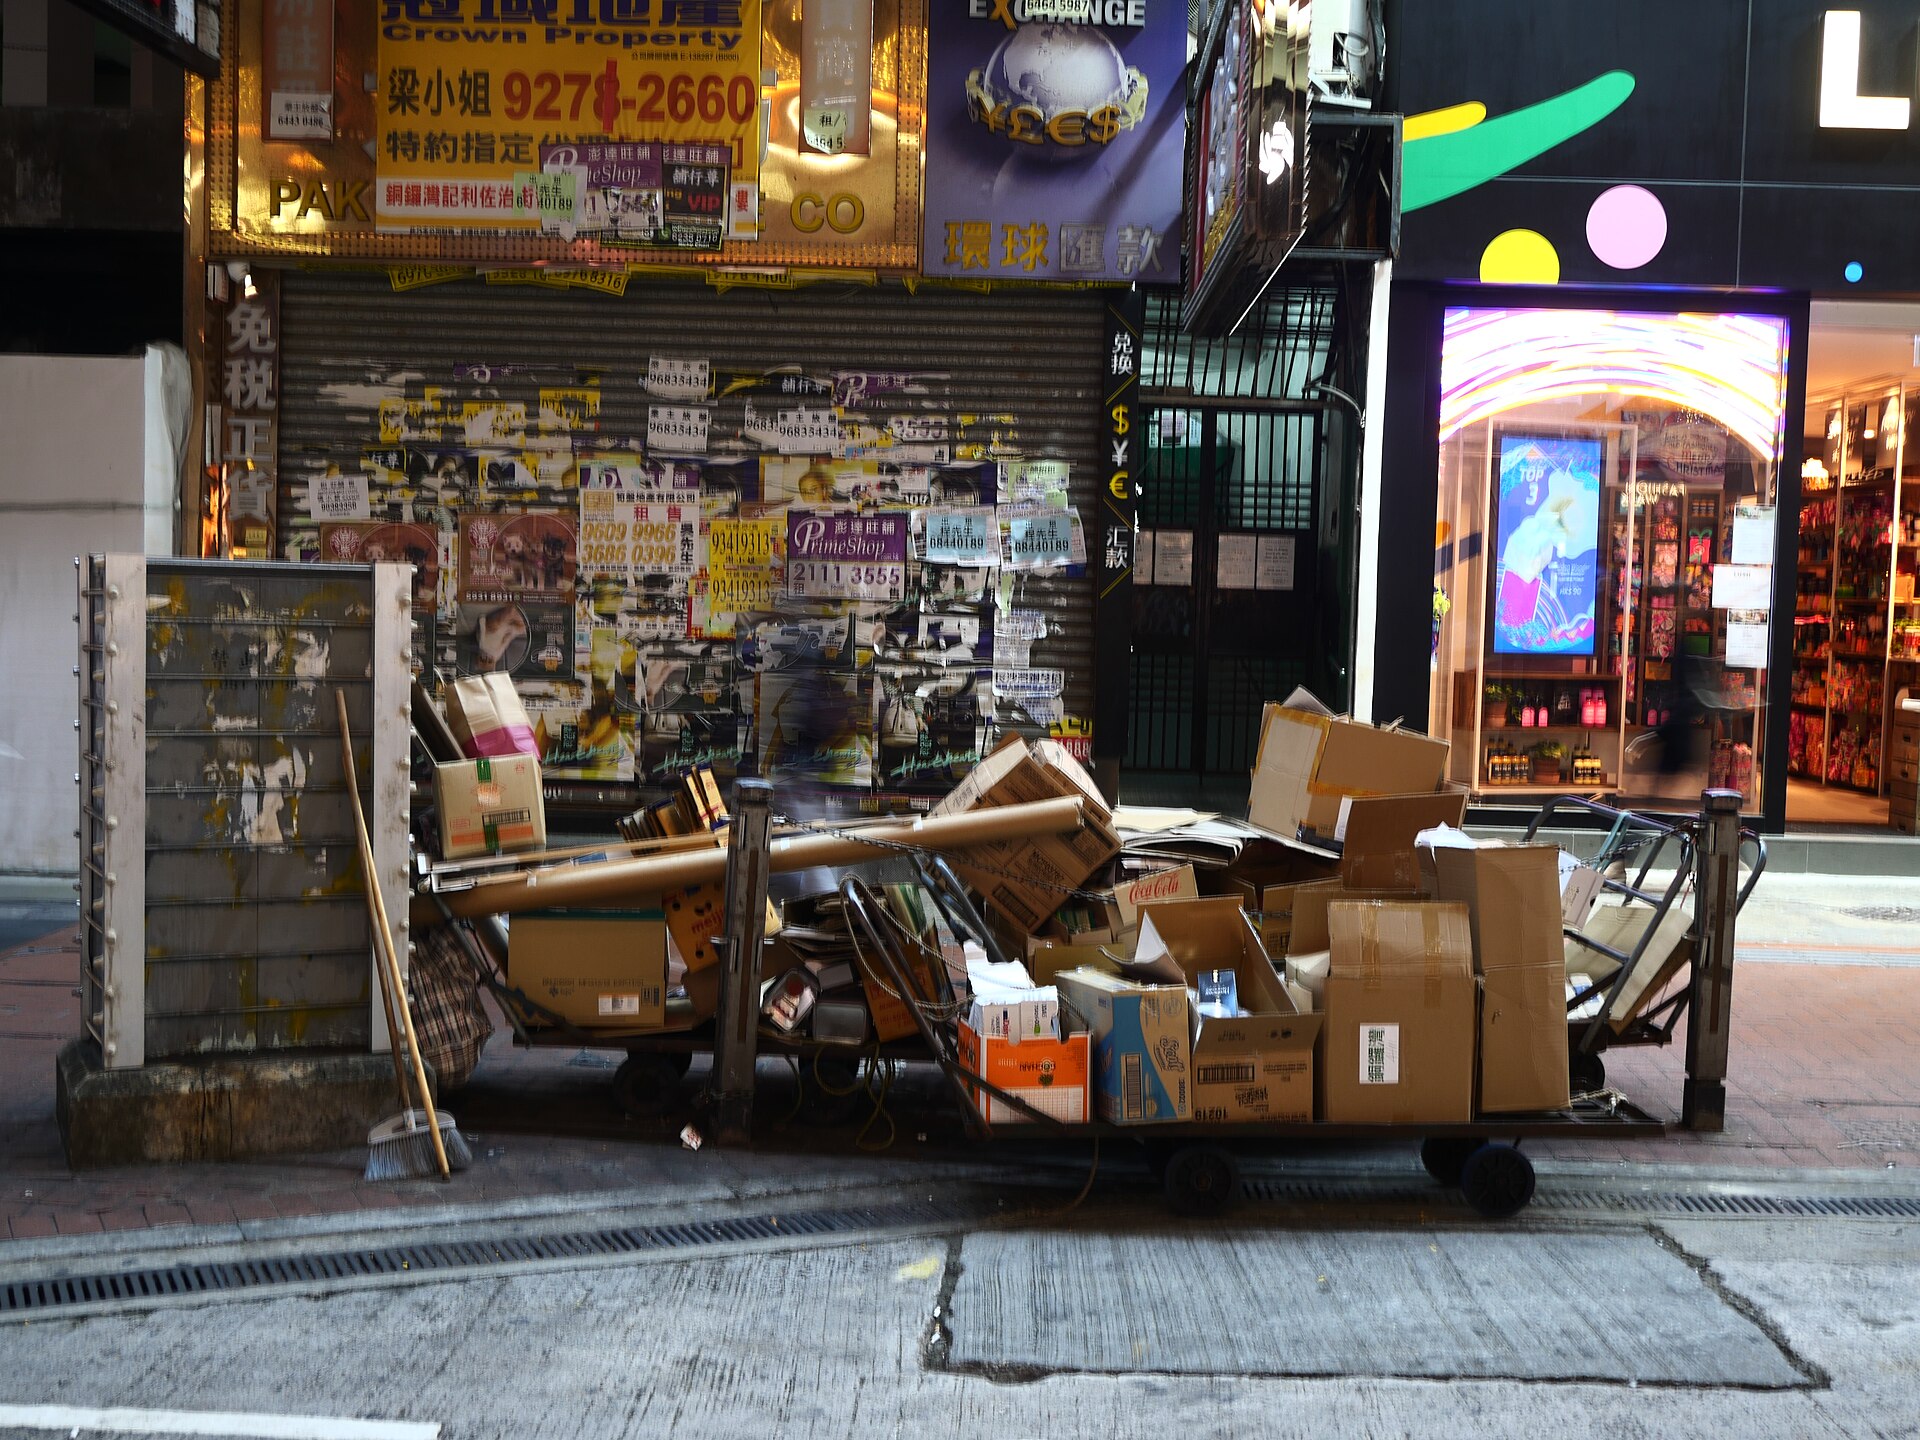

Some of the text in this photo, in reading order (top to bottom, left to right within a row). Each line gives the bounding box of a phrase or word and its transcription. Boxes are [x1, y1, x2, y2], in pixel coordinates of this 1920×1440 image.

[382, 24, 743, 51] Crown Property
[1819, 10, 1910, 129] L
[388, 66, 756, 125] 梁小姐 9278-2660
[270, 179, 371, 221] PAK
[688, 193, 721, 213] VIP
[790, 192, 865, 234] CO
[944, 220, 1165, 275] 環球匯款
[649, 371, 707, 388] 96835434
[224, 303, 276, 522] 免稅正貨
[649, 419, 707, 438] 96835434
[779, 423, 837, 439] 96835434
[1520, 466, 1544, 482] TOP
[633, 504, 649, 522] 租
[667, 505, 682, 523] 售
[581, 521, 677, 543] 9609 9966
[712, 530, 769, 555] 93419313
[794, 516, 885, 561] PrimeShop
[581, 543, 677, 565] 3686 0396
[793, 562, 900, 585] 2111 3555
[712, 577, 770, 603] 93419313
